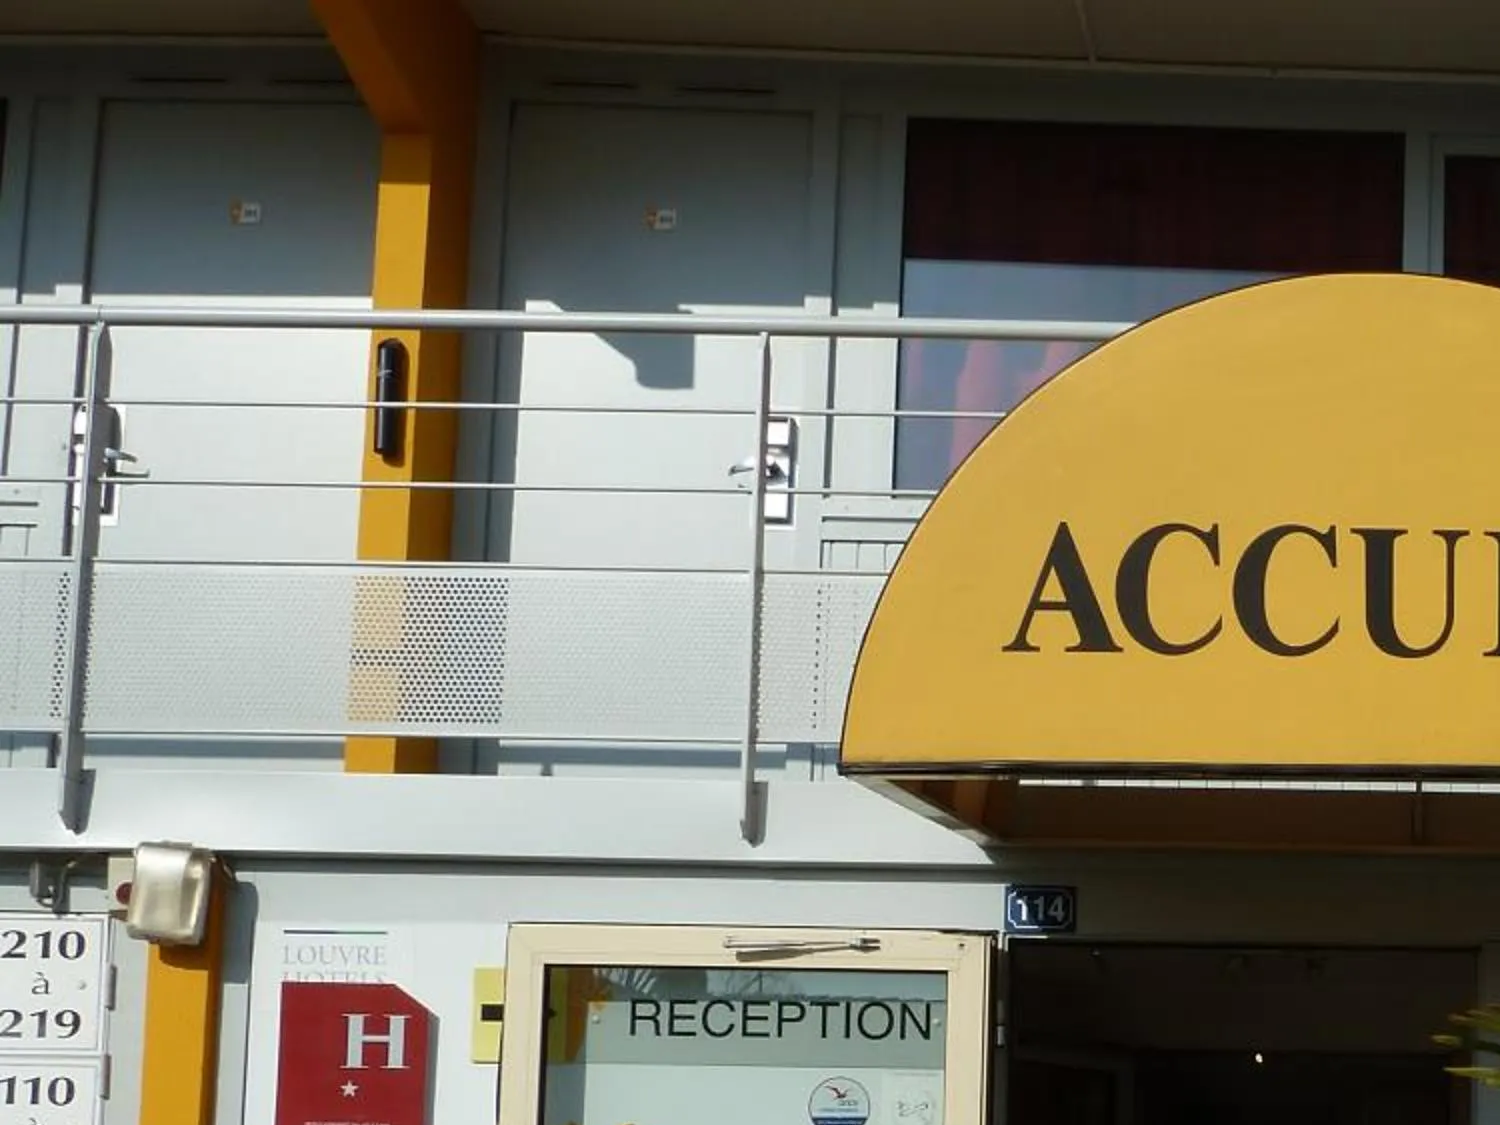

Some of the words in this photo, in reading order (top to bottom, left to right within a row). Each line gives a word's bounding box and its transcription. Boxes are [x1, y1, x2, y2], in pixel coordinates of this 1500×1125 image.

[1016, 895, 1064, 922] 114
[0, 930, 86, 960] 210
[283, 943, 387, 965] LOUVRE
[31, 971, 50, 995] à
[0, 1009, 82, 1038] 219
[629, 999, 931, 1040] RECEPTION
[339, 1013, 413, 1069] H
[0, 1075, 75, 1106] 110
